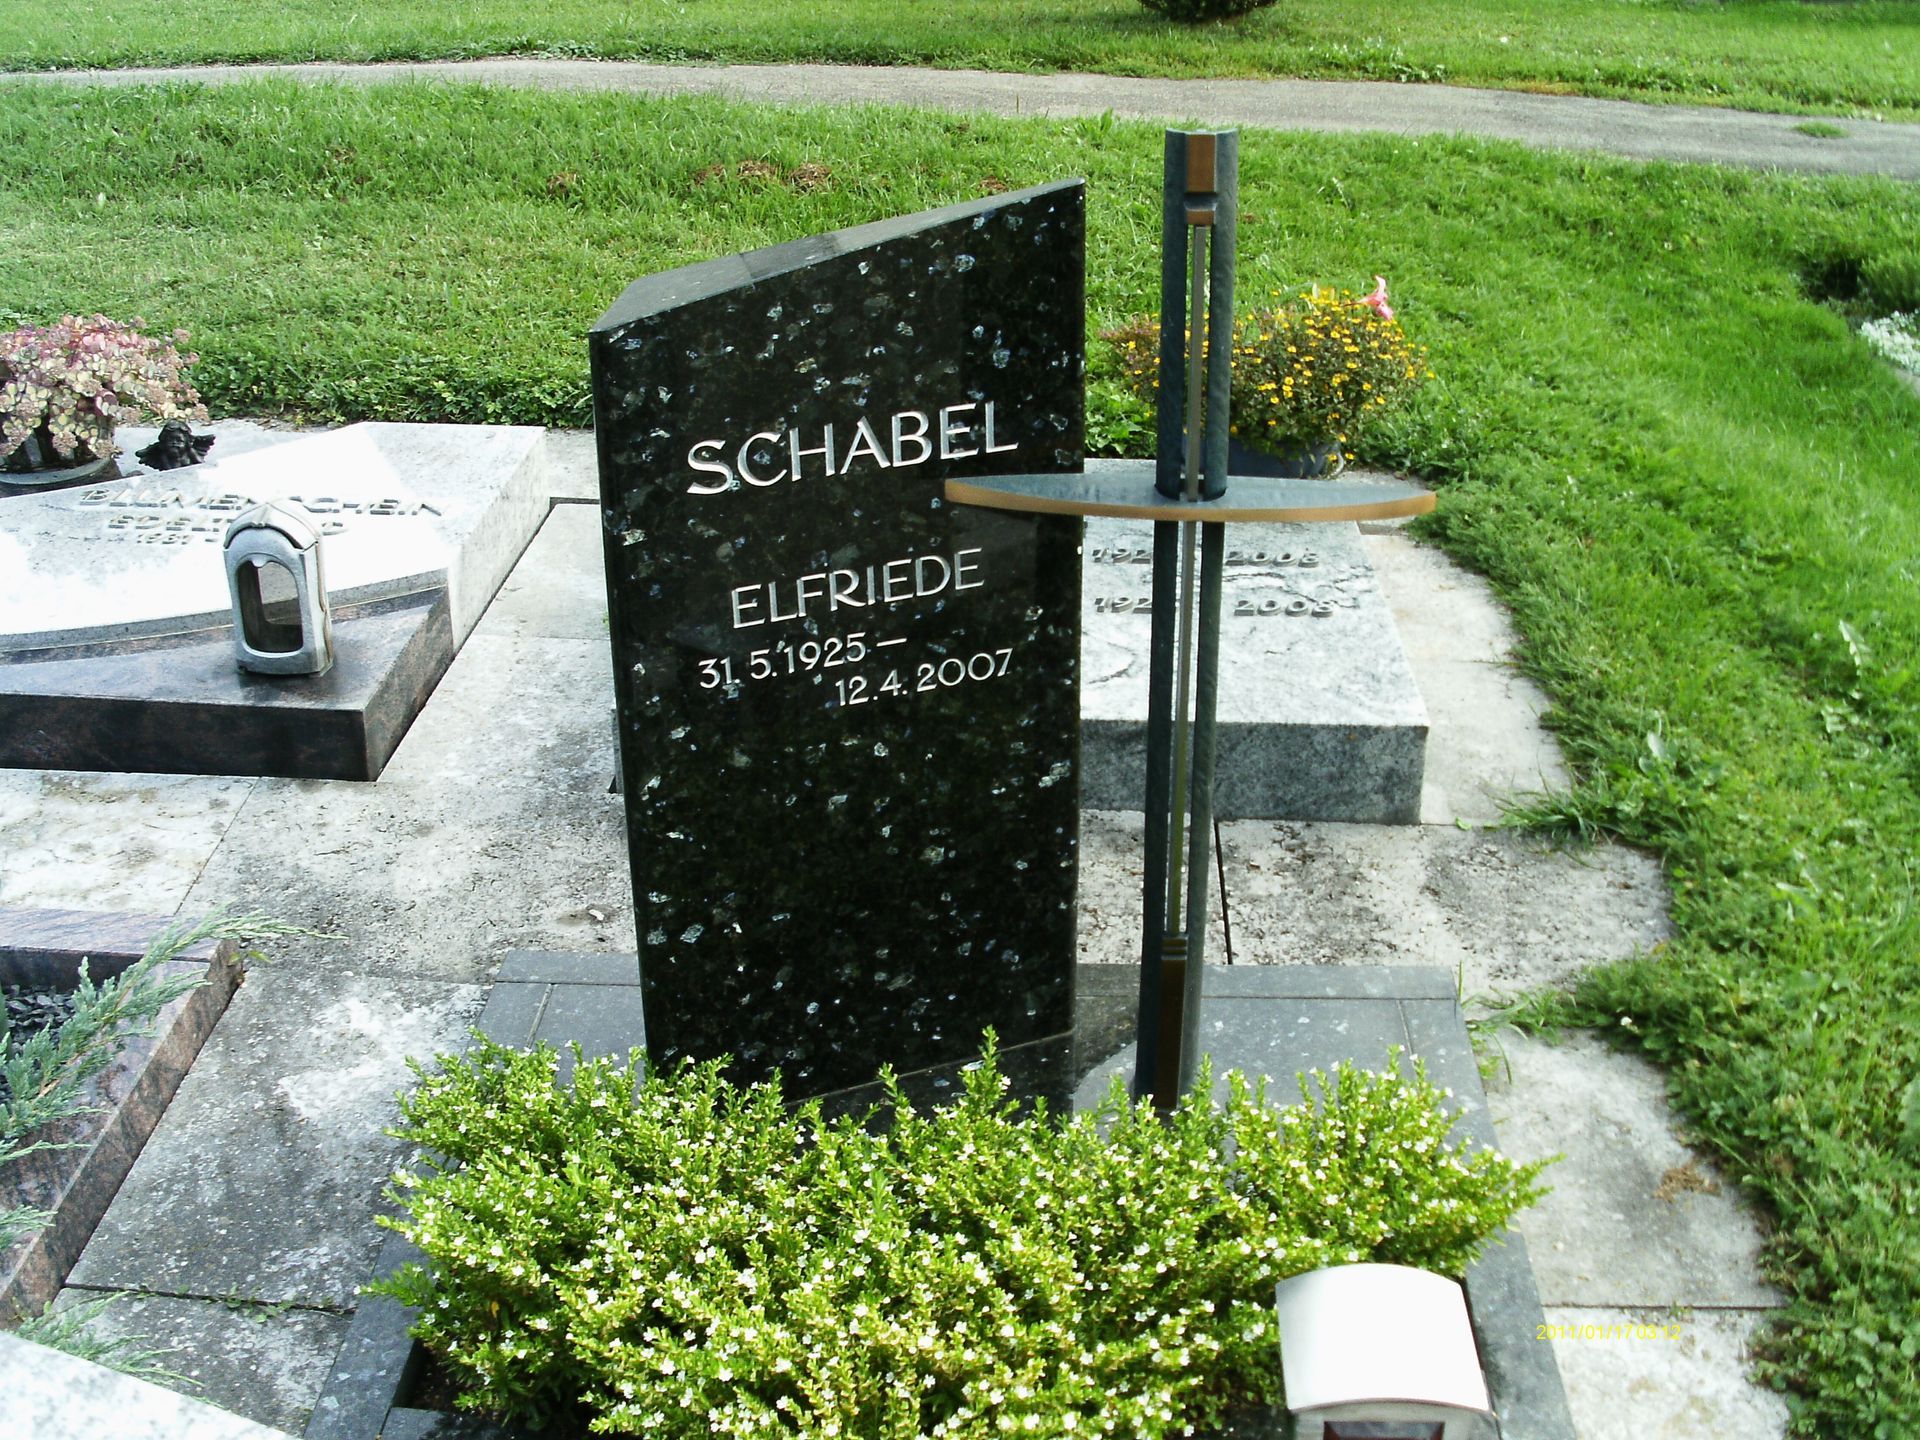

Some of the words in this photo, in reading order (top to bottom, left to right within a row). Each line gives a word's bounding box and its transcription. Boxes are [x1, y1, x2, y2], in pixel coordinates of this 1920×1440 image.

[686, 400, 1020, 495] SCHABEL
[107, 513, 350, 537] EDELTD
[1092, 548, 1153, 565] 192
[731, 548, 985, 629] ELFRIEDE
[1094, 597, 1153, 615] 192
